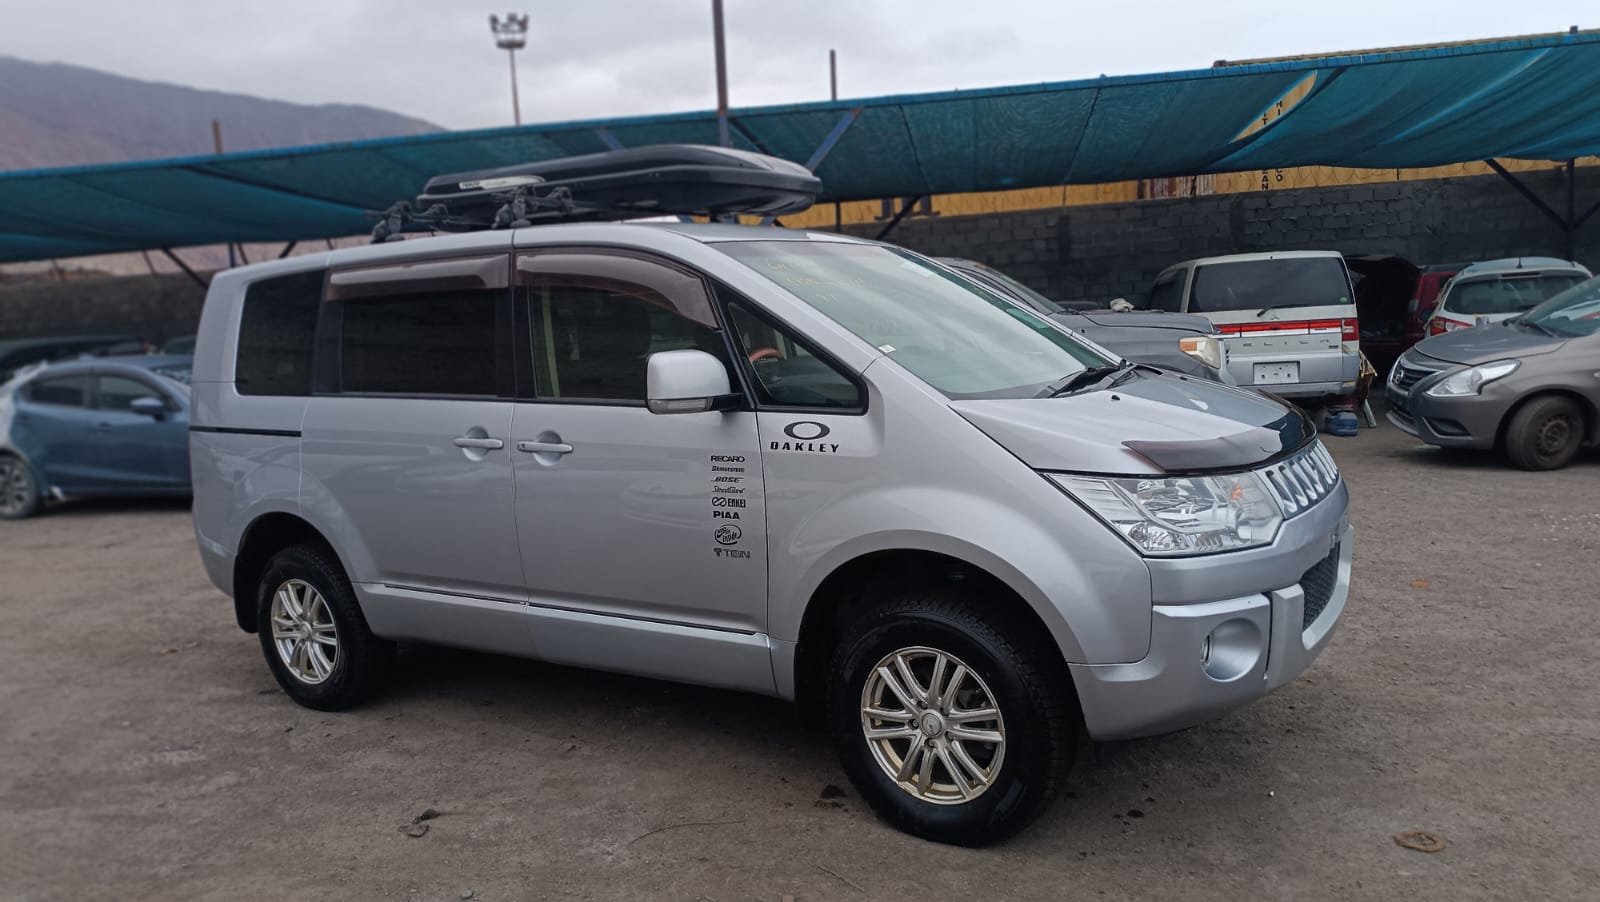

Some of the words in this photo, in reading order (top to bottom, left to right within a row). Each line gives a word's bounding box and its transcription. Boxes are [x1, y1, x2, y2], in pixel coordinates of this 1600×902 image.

[770, 441, 840, 453] OAKLEY
[710, 455, 746, 463] RECARO
[727, 498, 746, 508] ENKEI
[713, 510, 740, 519] PIAA
[723, 548, 751, 559] TEIN
